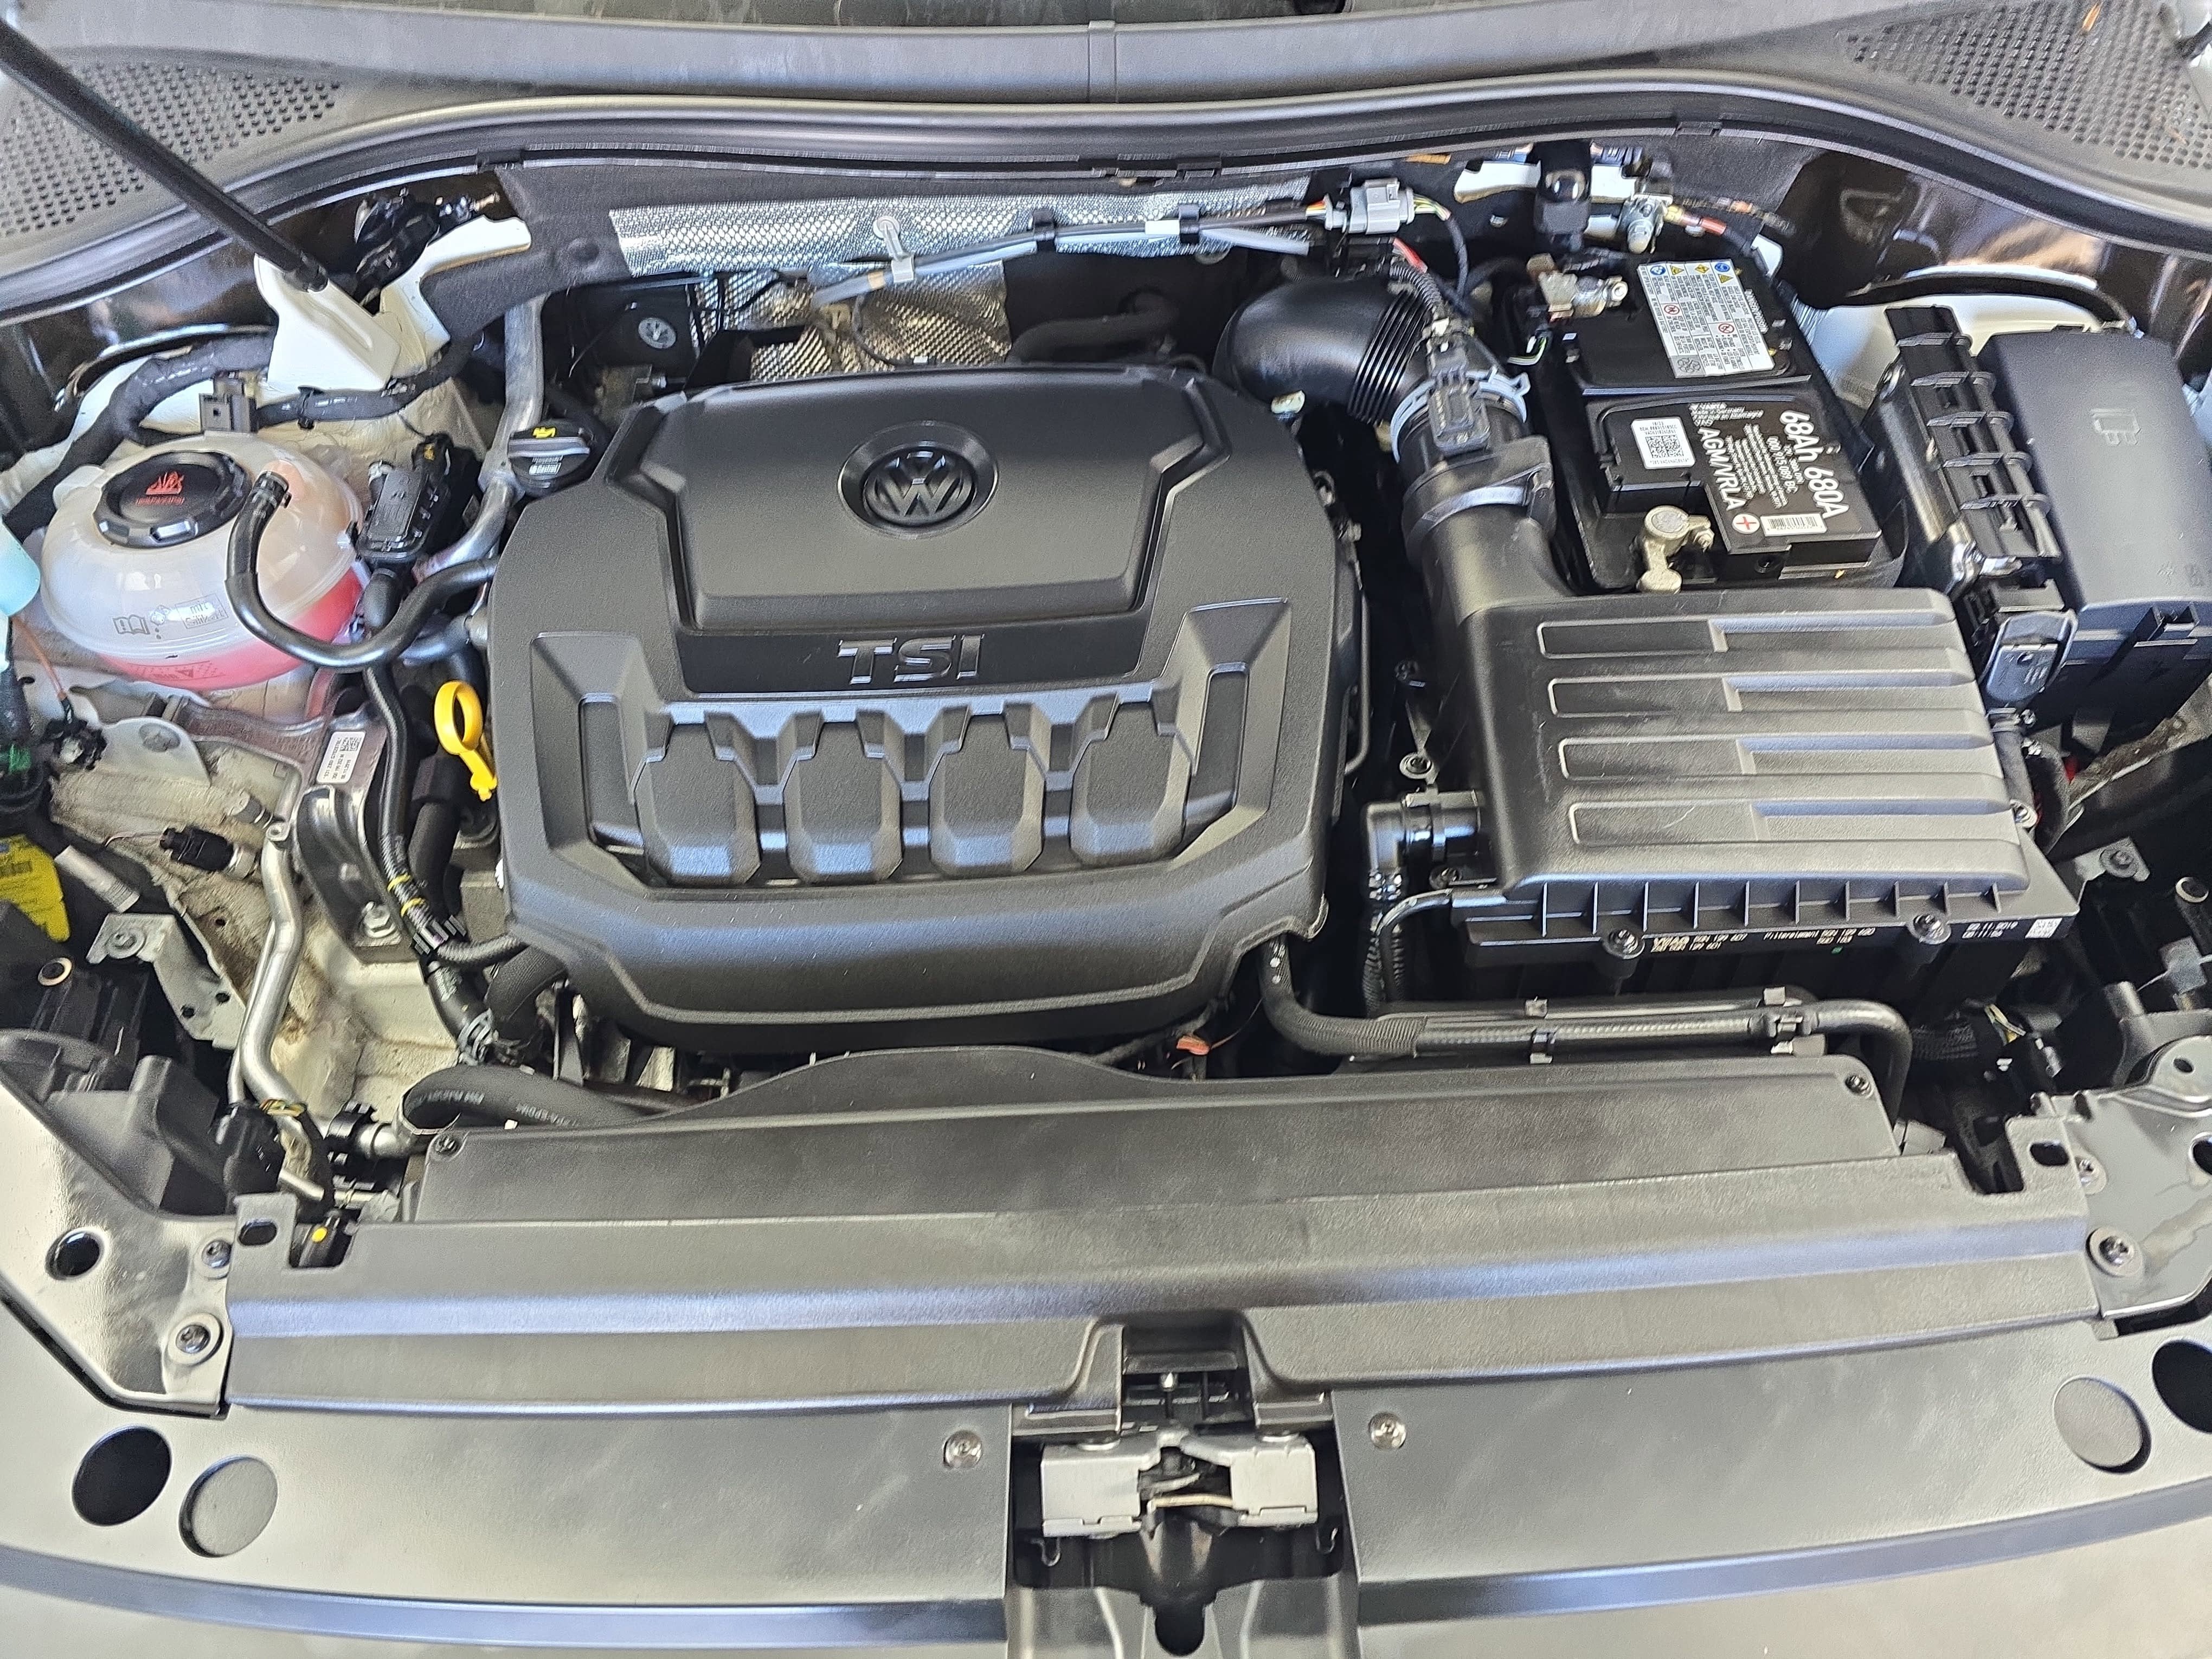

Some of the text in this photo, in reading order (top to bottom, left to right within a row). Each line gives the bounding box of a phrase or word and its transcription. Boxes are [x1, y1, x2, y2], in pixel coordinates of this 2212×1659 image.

[1767, 436, 1782, 452] 000
[1771, 451, 1789, 465] 915
[1779, 410, 1849, 520] 68Ah 680A
[1778, 466, 1792, 479] 089
[190, 601, 209, 614] mit
[837, 633, 985, 685] TSI
